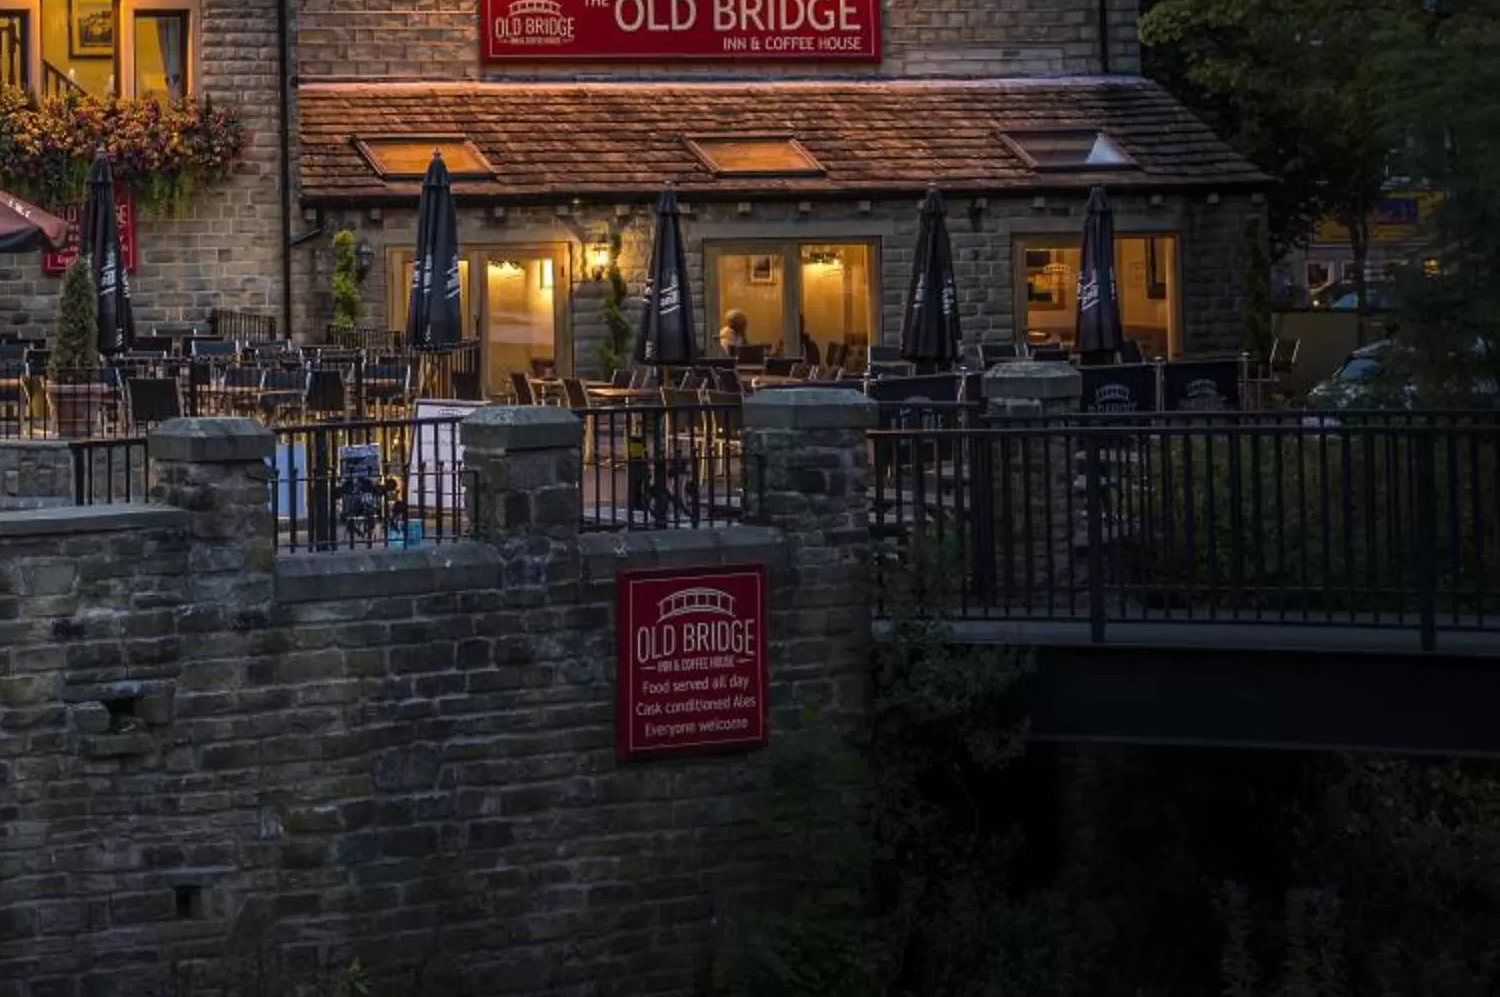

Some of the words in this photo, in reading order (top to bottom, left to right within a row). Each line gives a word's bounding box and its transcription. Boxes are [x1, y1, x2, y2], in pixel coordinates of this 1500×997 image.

[495, 17, 522, 39] OLD
[525, 16, 575, 39] BRIDGE
[723, 37, 747, 50] INN
[750, 37, 761, 50] &
[765, 37, 815, 50] COFFEE
[818, 37, 862, 50] HOUSE
[637, 624, 676, 663] OLD
[683, 618, 756, 656] BRIDGE
[643, 680, 670, 695] Food
[672, 676, 709, 692] served
[711, 675, 727, 690] all
[729, 674, 749, 691] day
[636, 701, 663, 716] Cask
[664, 696, 731, 714] conditioned
[645, 722, 697, 738] Everyone
[698, 717, 749, 732] welcome
